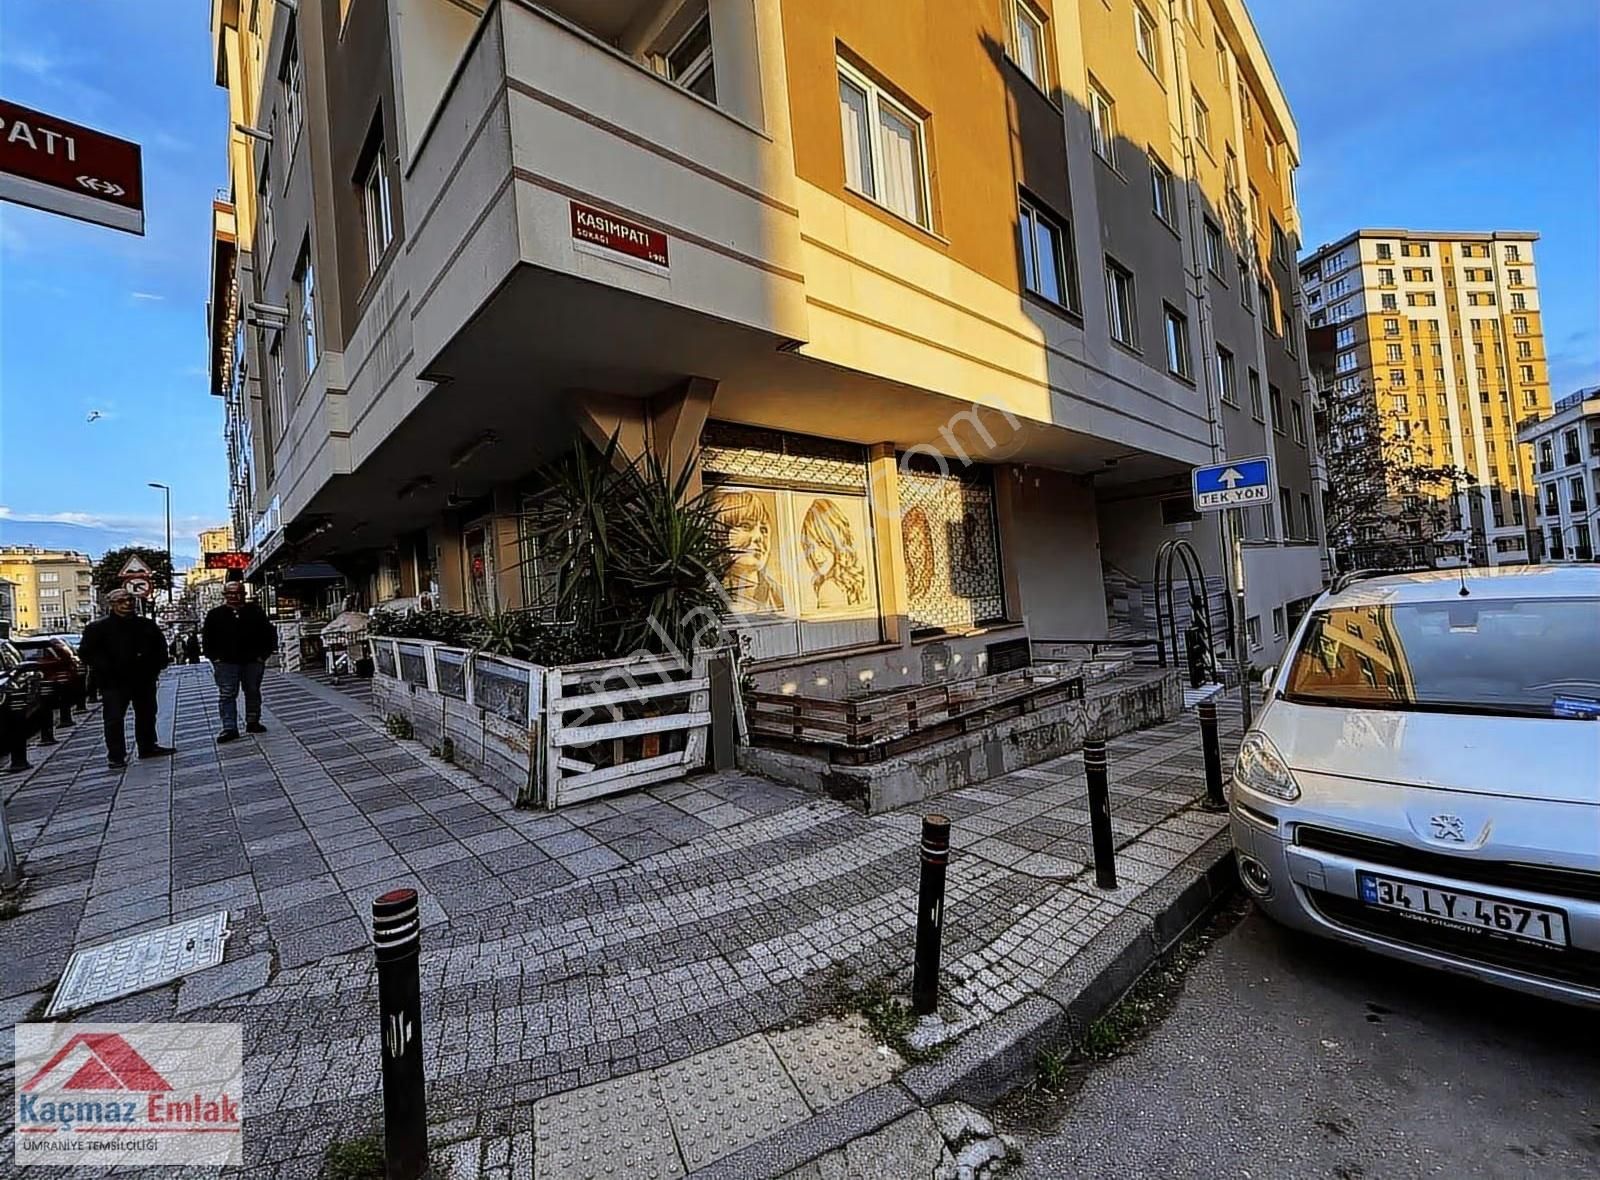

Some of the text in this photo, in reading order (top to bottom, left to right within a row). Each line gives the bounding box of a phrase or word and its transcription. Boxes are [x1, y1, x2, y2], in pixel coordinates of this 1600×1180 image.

[576, 209, 649, 247] KASIMPATI
[1201, 492, 1229, 505] TEK
[1378, 881, 1554, 941] 34 LY 4671
